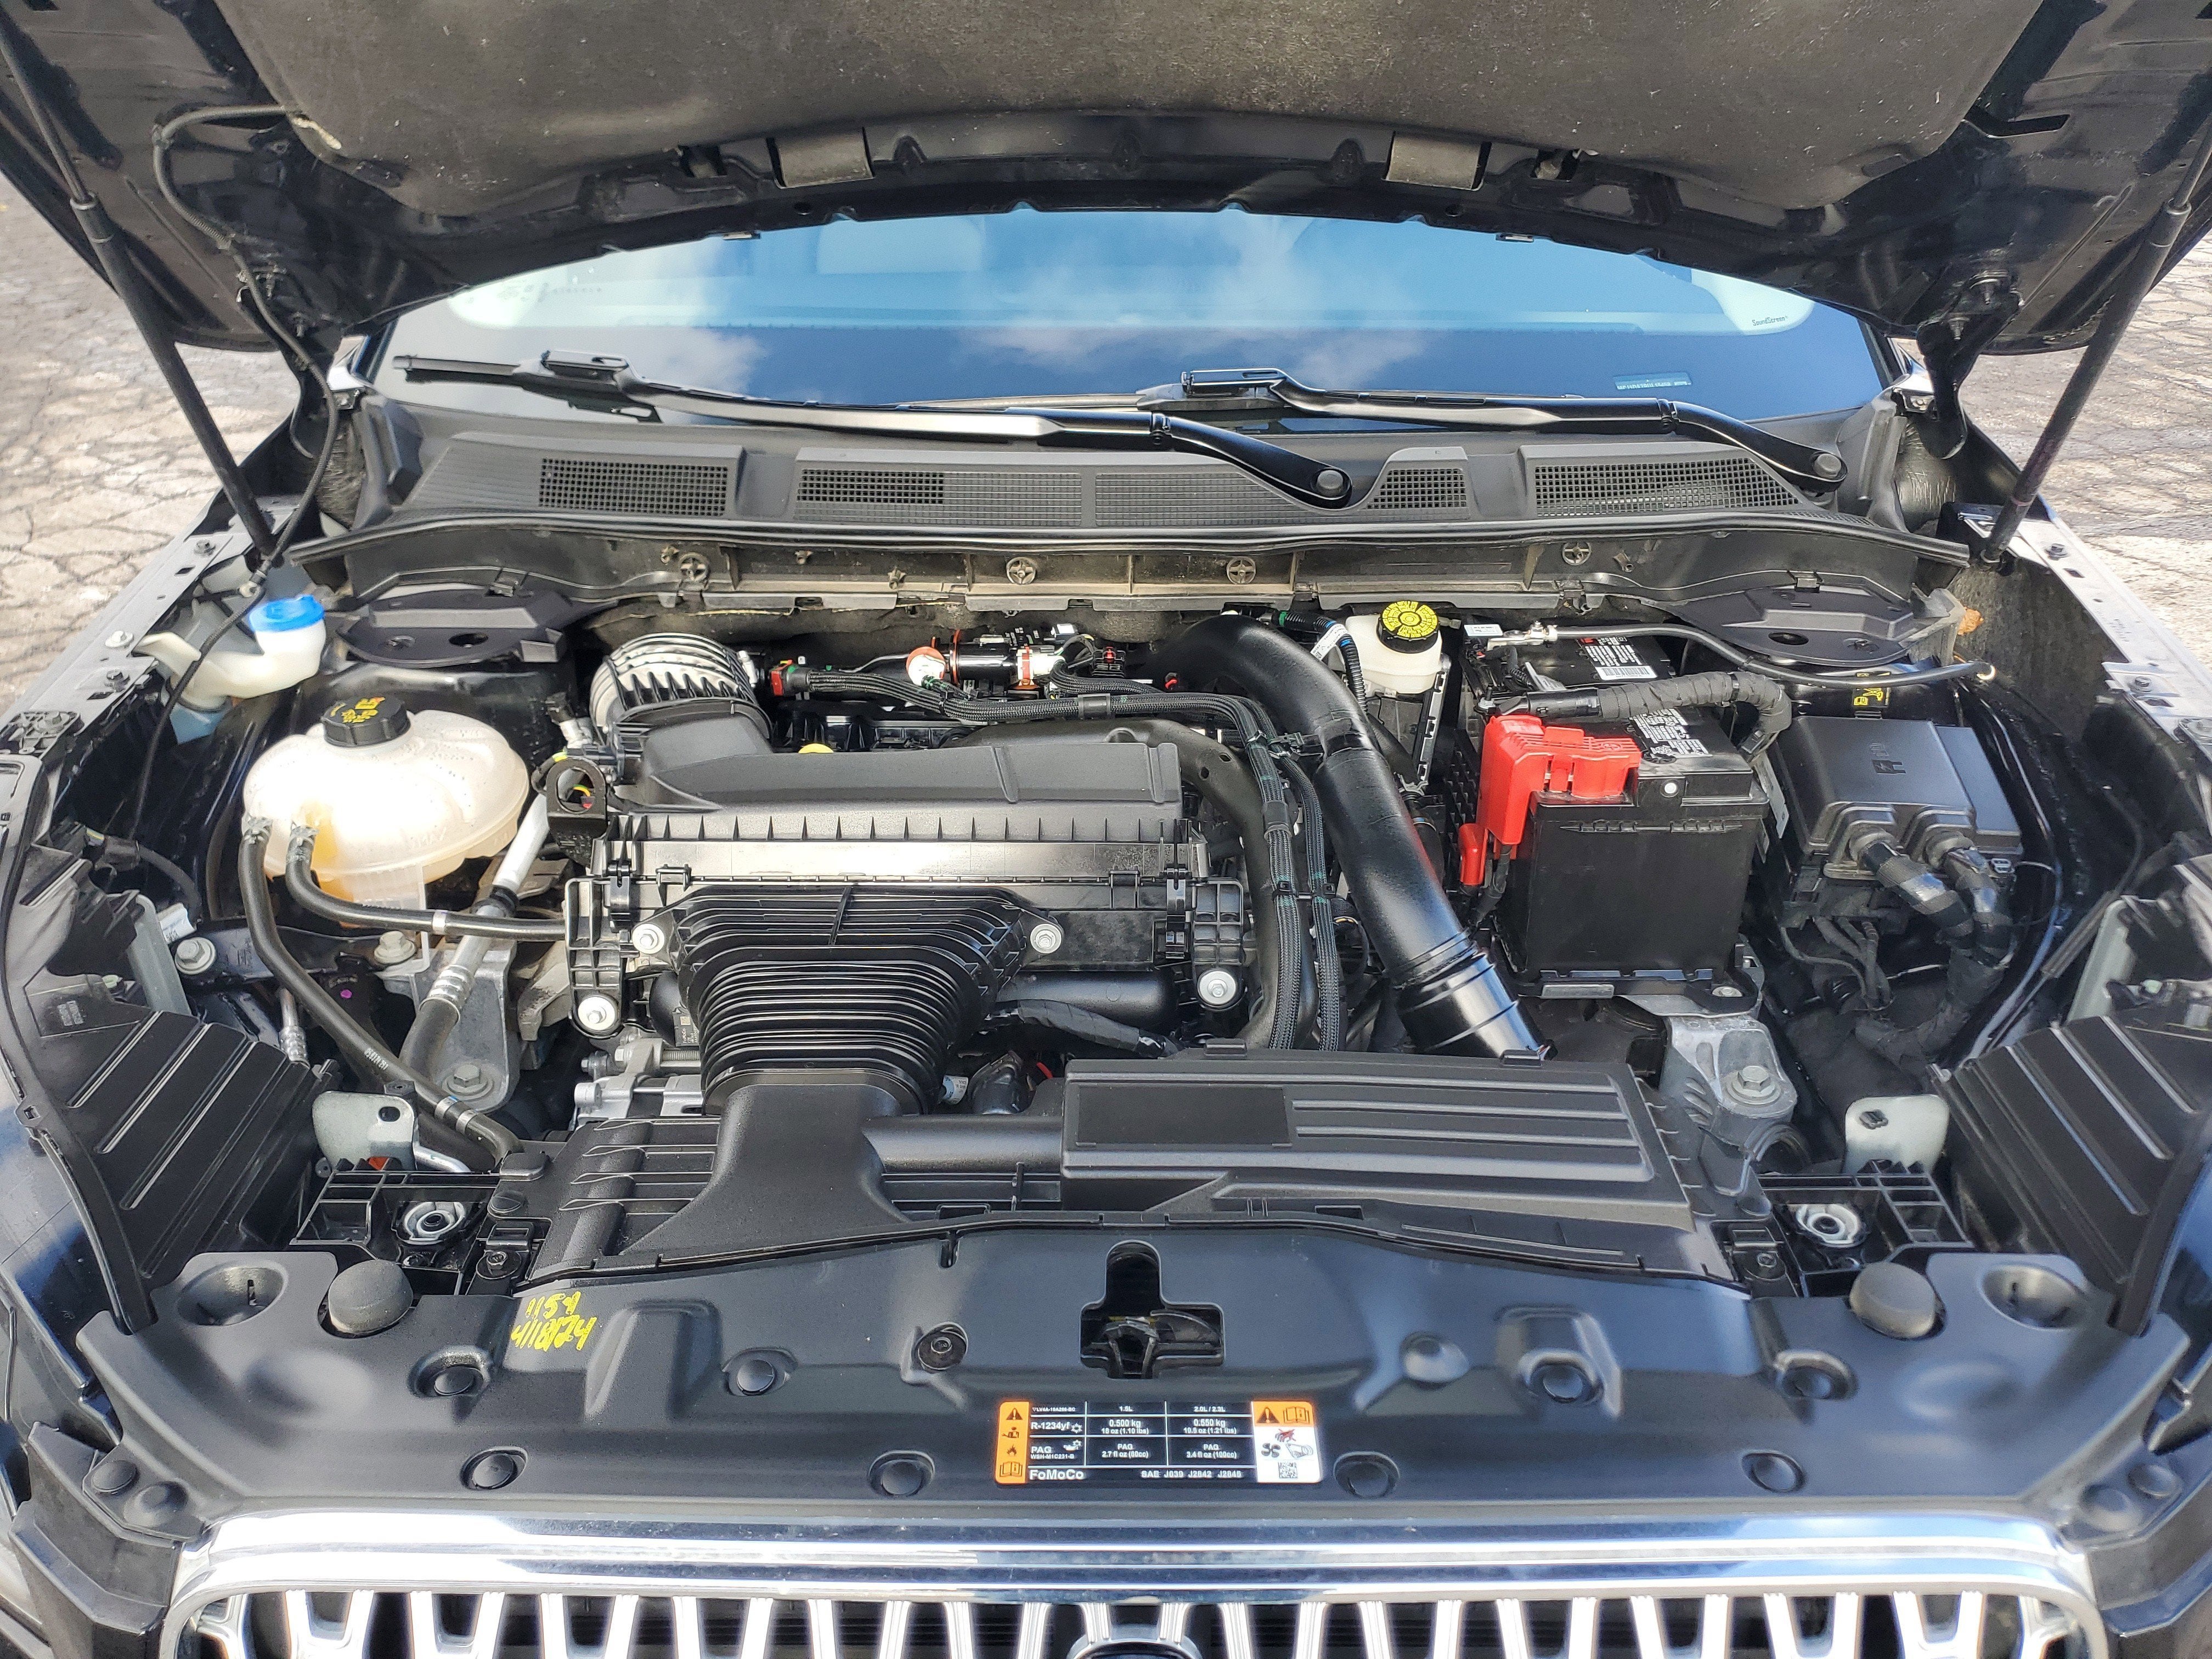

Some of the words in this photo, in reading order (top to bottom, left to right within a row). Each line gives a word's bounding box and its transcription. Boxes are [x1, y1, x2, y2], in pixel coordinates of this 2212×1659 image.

[1031, 1421, 1070, 1431] R-1234yf
[1131, 1419, 1141, 1428] kg
[1193, 1418, 1214, 1426] 0.550
[1216, 1418, 1226, 1428] kg
[1029, 1469, 1084, 1480] FoMoCo
